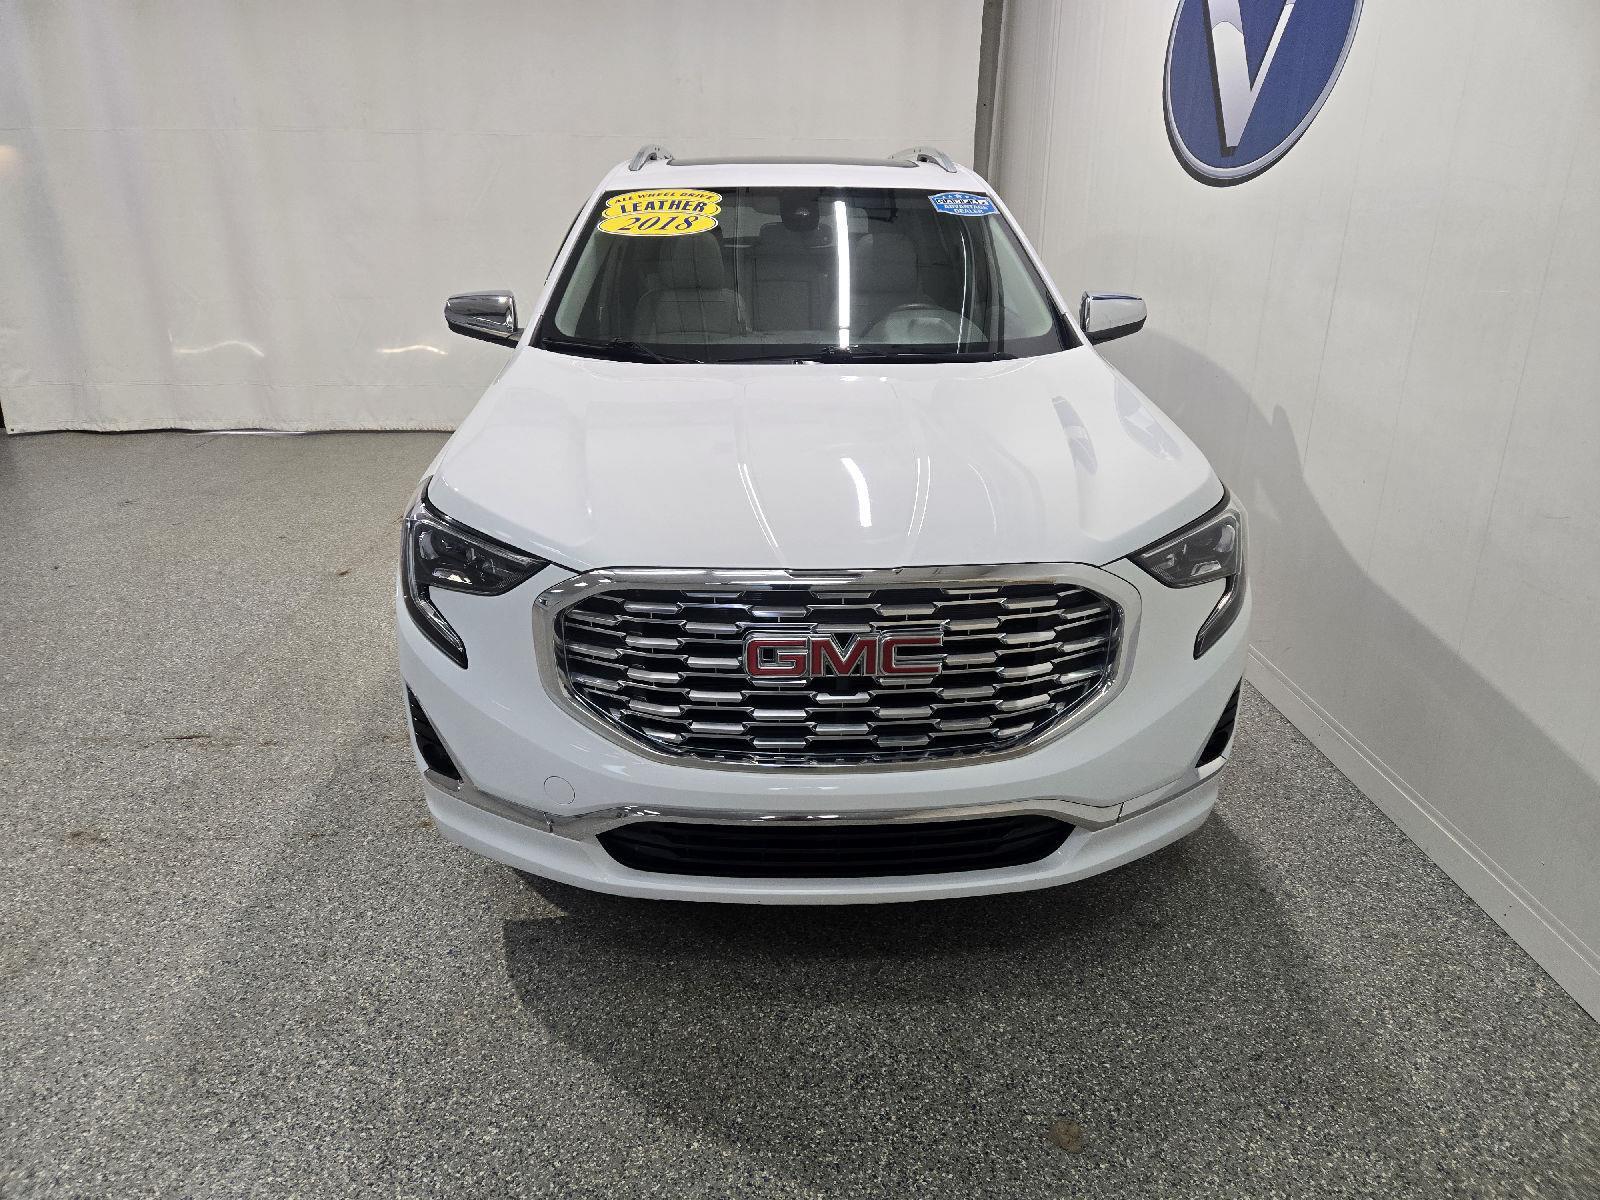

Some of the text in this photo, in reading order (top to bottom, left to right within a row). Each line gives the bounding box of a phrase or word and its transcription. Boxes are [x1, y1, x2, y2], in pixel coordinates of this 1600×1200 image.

[615, 196, 633, 204] ALL
[620, 200, 707, 214] LEATHER
[618, 215, 699, 231] 2018
[742, 630, 944, 678] GMC
